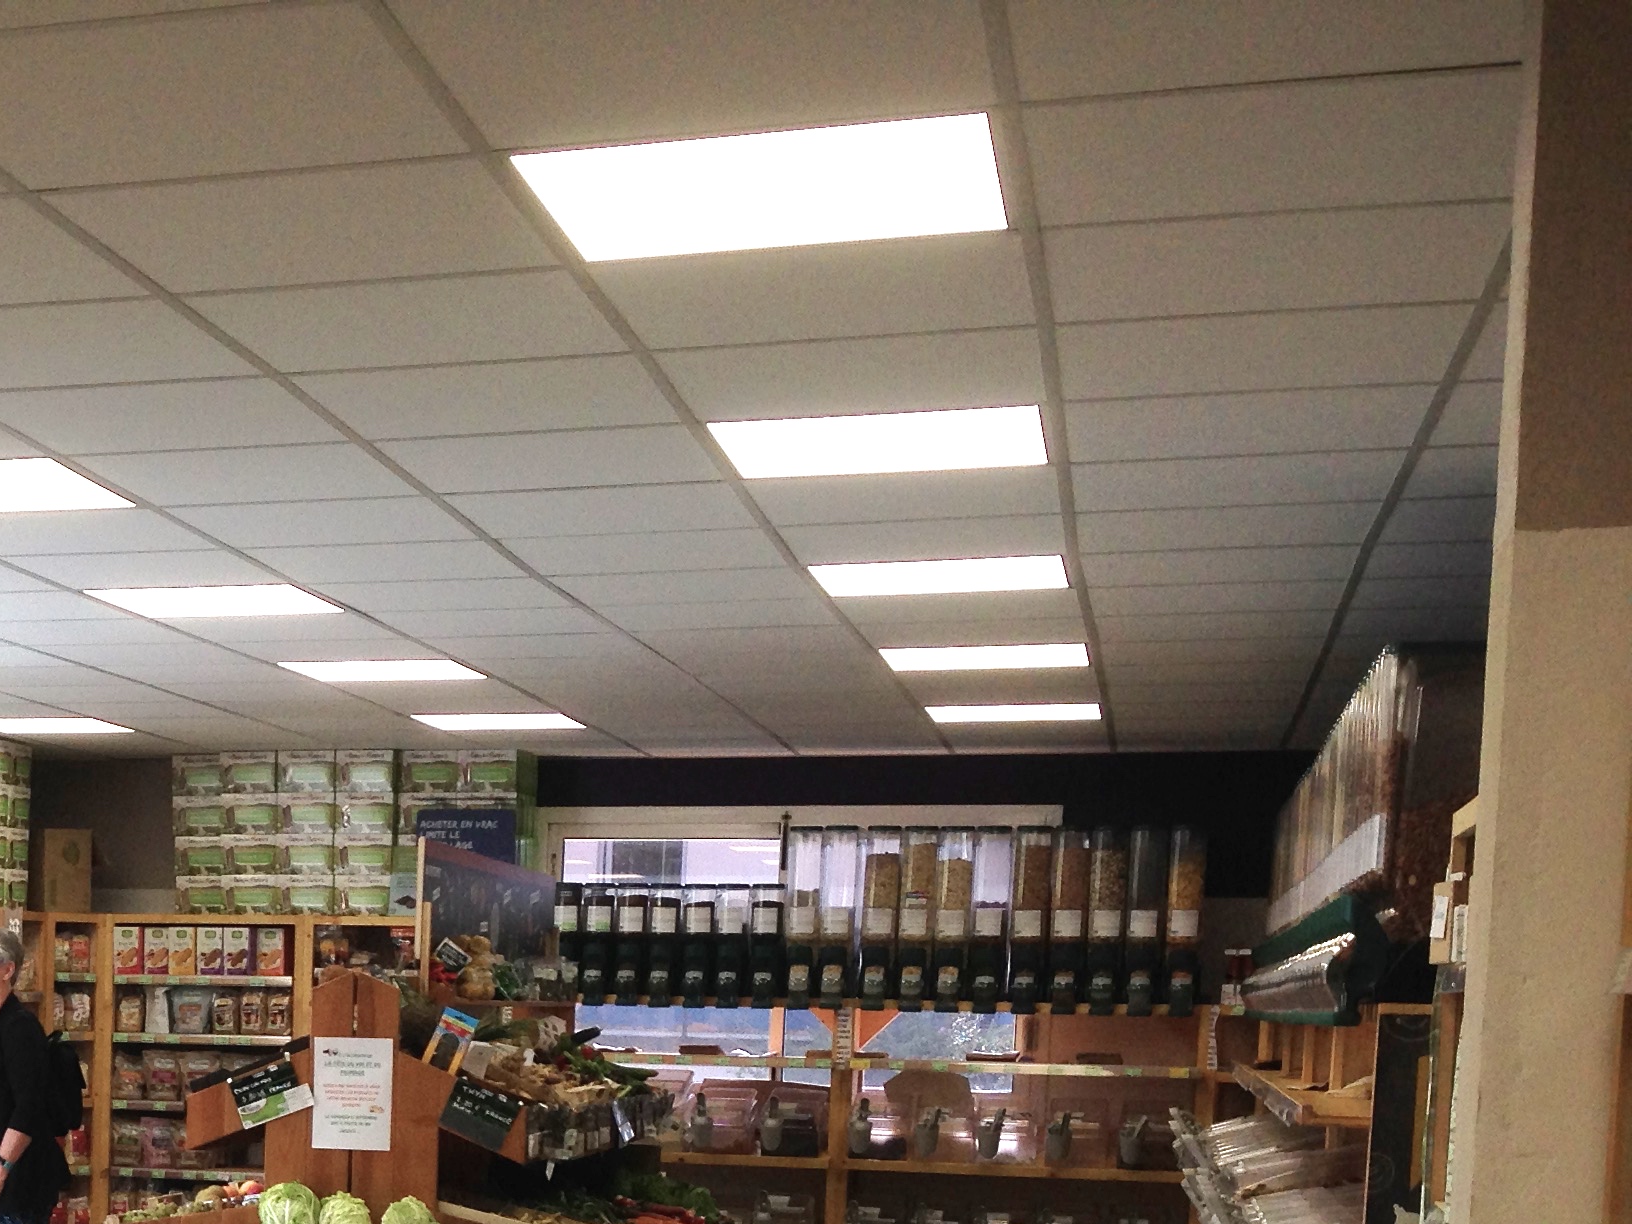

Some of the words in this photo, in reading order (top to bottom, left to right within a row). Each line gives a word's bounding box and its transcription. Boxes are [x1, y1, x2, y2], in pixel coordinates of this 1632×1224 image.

[460, 820, 473, 829] EN
[475, 820, 498, 830] VRAC
[449, 830, 461, 839] LE
